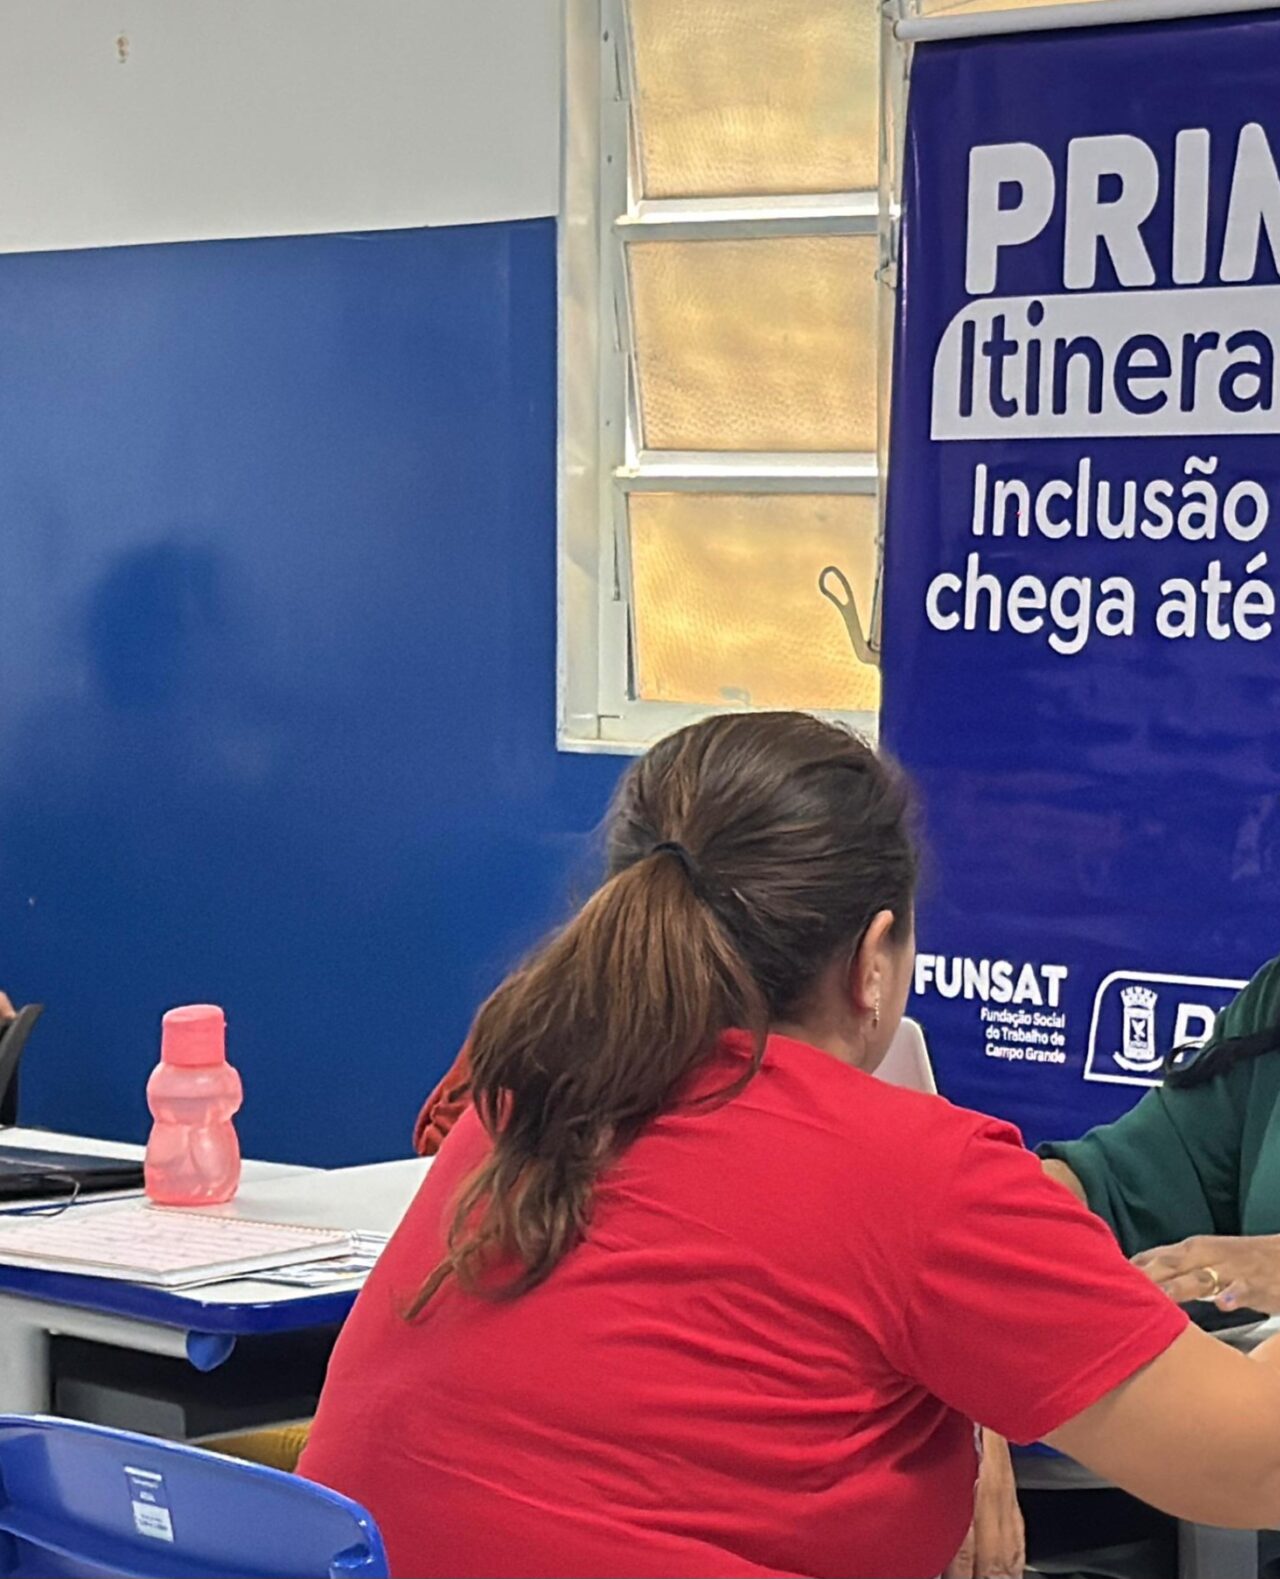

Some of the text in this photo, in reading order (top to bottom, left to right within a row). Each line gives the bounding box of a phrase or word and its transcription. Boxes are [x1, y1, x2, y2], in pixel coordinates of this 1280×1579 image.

[972, 456, 1269, 541] Inclusão
[925, 552, 1135, 654] chega
[1156, 551, 1275, 640] até
[915, 954, 1068, 1007] FUNSAT
[981, 1007, 1065, 1028] Fundação Social
[986, 1025, 1065, 1046] do Trabalho de
[985, 1043, 1066, 1063] Campo Grande
